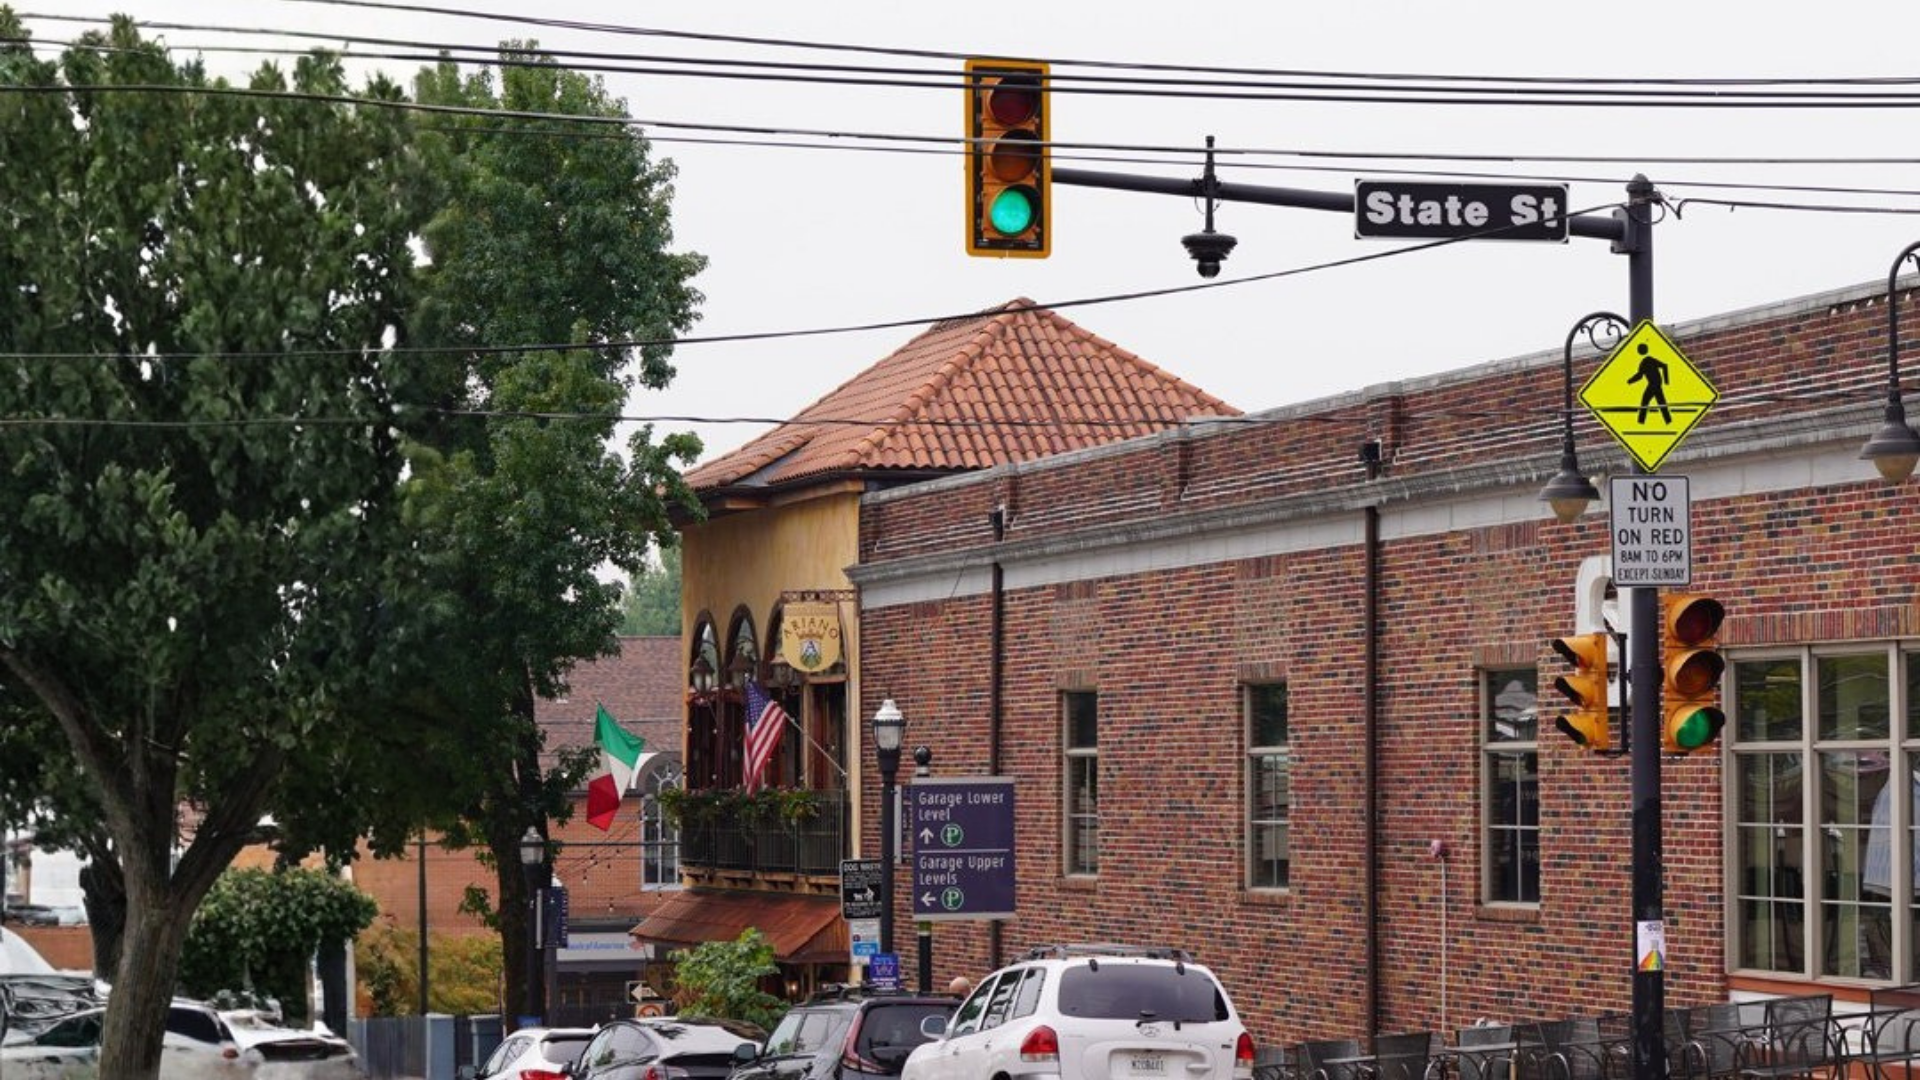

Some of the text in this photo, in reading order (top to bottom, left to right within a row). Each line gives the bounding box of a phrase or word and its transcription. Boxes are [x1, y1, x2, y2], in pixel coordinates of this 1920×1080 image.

[1366, 190, 1558, 228] State St
[1632, 482, 1668, 502] NO
[1627, 507, 1674, 523] TURN
[1618, 528, 1684, 546] ON RED
[1621, 550, 1683, 563] 8AM TO 6PM
[1618, 568, 1686, 581] EXCEPT SUNDAY
[784, 617, 838, 640] ARIANO
[919, 792, 1005, 808] Garage Lower
[919, 807, 951, 821] Level
[946, 827, 960, 843] P
[919, 856, 1005, 872] Garage Upper
[919, 872, 958, 885] Levels
[946, 891, 960, 907] P
